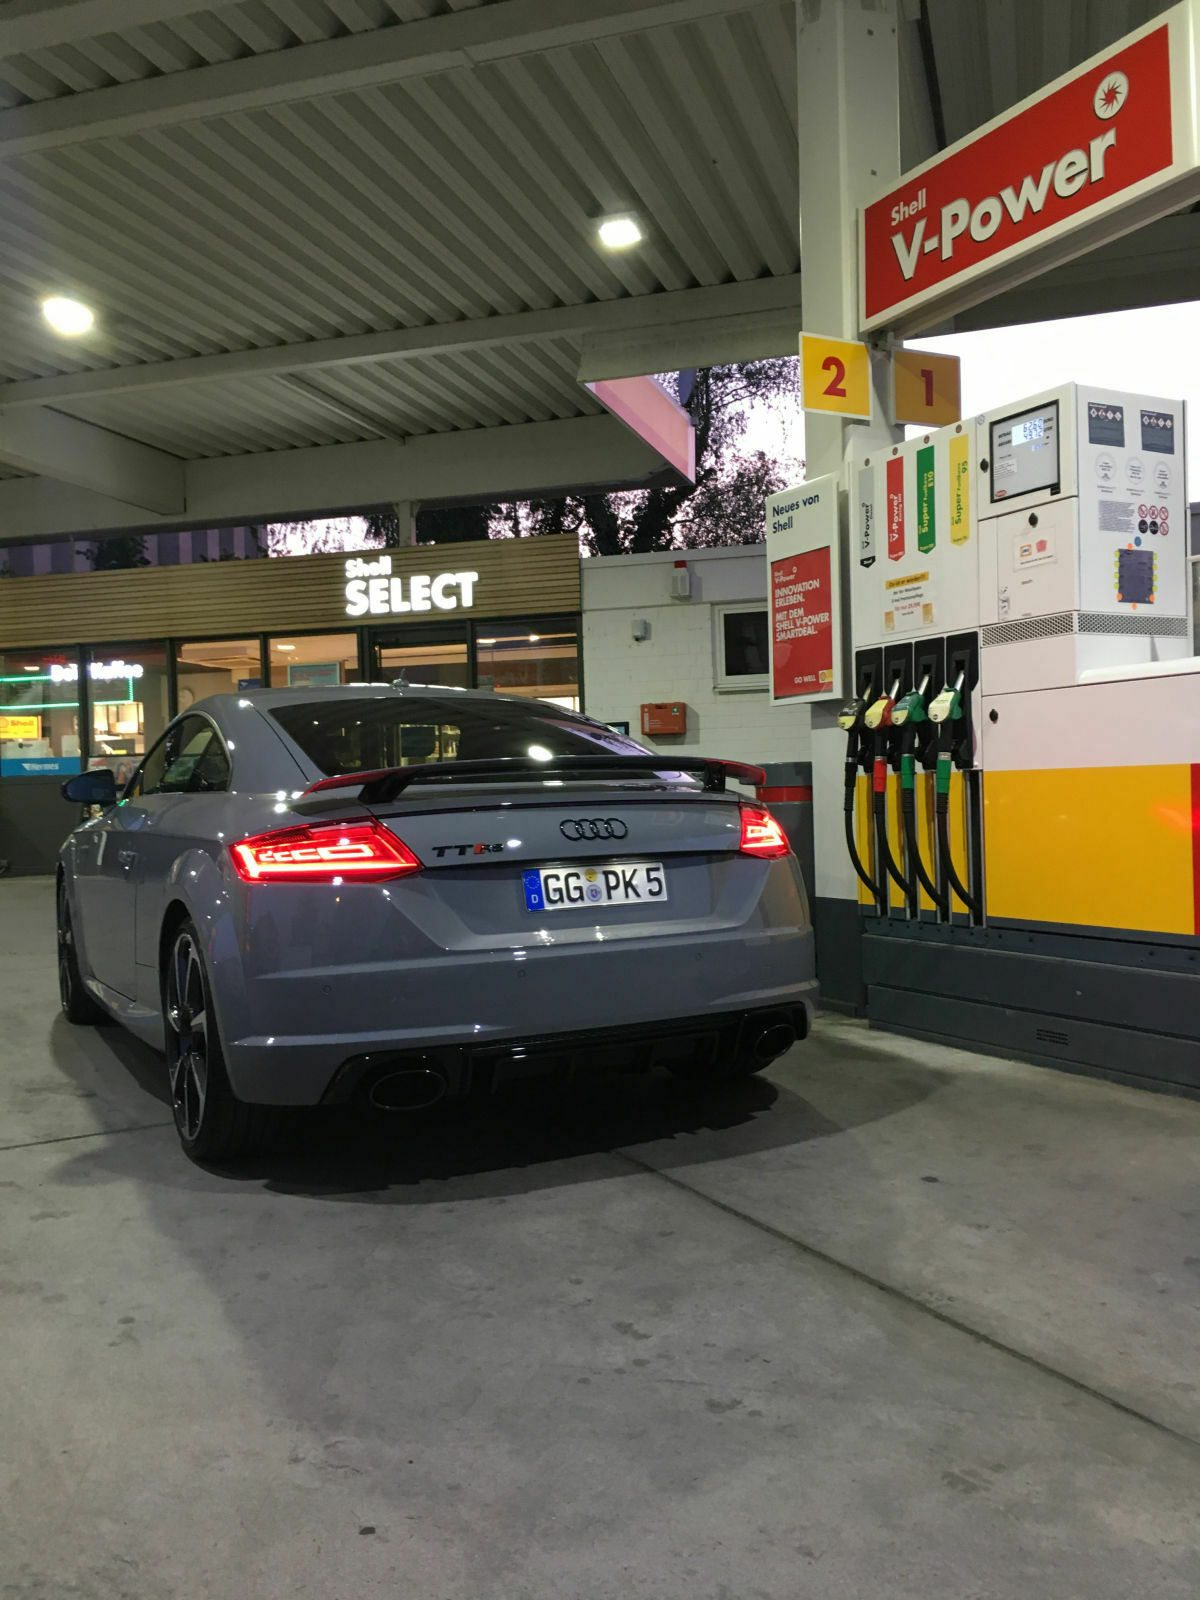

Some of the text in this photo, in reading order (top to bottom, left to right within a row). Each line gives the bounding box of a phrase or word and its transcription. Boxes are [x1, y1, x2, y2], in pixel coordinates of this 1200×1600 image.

[890, 127, 1117, 281] V-Power
[891, 188, 926, 226] Shell
[821, 356, 847, 398] 2
[920, 368, 934, 407] 1
[927, 471, 935, 487] E10
[961, 461, 968, 473] 95
[772, 494, 820, 518] Neues von
[891, 495, 899, 541] V-Power
[921, 503, 930, 533] Super
[955, 494, 963, 525] Super
[772, 516, 793, 534] Shell
[345, 555, 393, 579] Shell
[345, 571, 479, 616] SELECT
[775, 578, 820, 598] INNOVATION
[775, 593, 805, 608] ERLEBEN.
[776, 607, 805, 622] MIT DEM
[776, 612, 830, 632] SHELL V-POWER
[776, 625, 818, 642] SMARTDEAL.
[432, 844, 474, 857] TT
[531, 867, 663, 904] D GG PK 5
